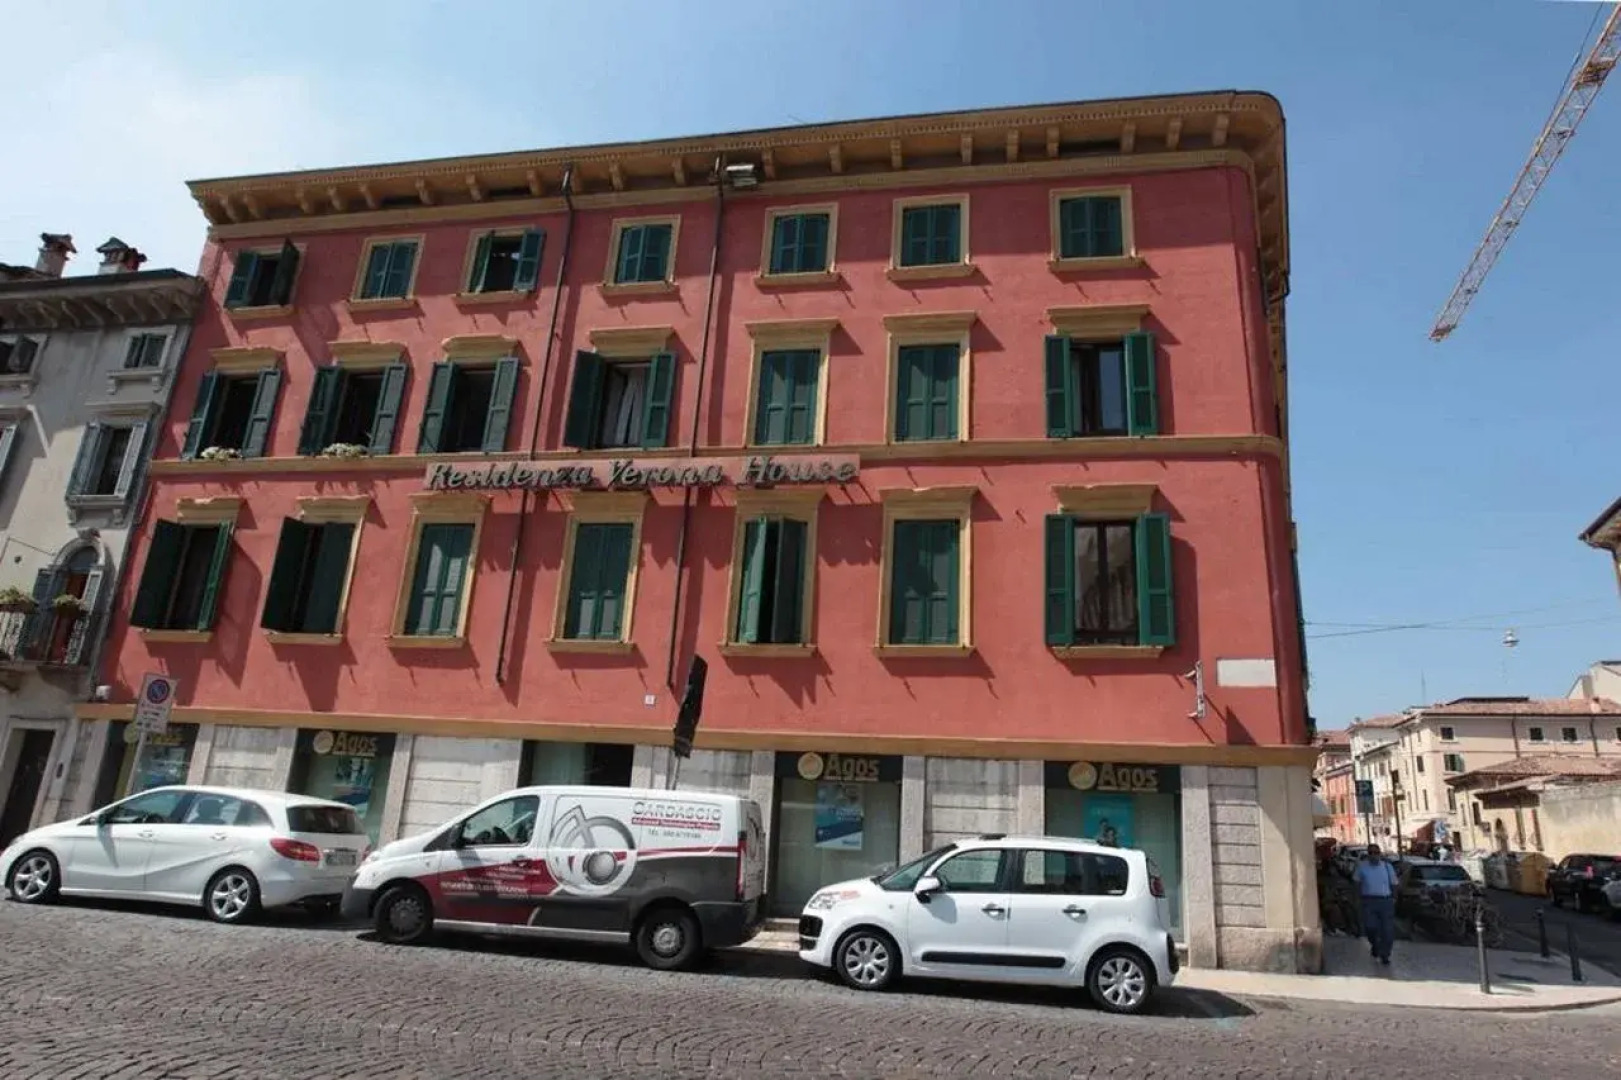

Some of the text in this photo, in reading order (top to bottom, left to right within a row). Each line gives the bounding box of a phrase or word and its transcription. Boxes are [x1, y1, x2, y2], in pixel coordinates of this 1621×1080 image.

[426, 455, 857, 490] Residenza Verona House
[332, 731, 378, 756] Agos
[823, 753, 879, 781] Agos
[1097, 763, 1158, 790] Agos
